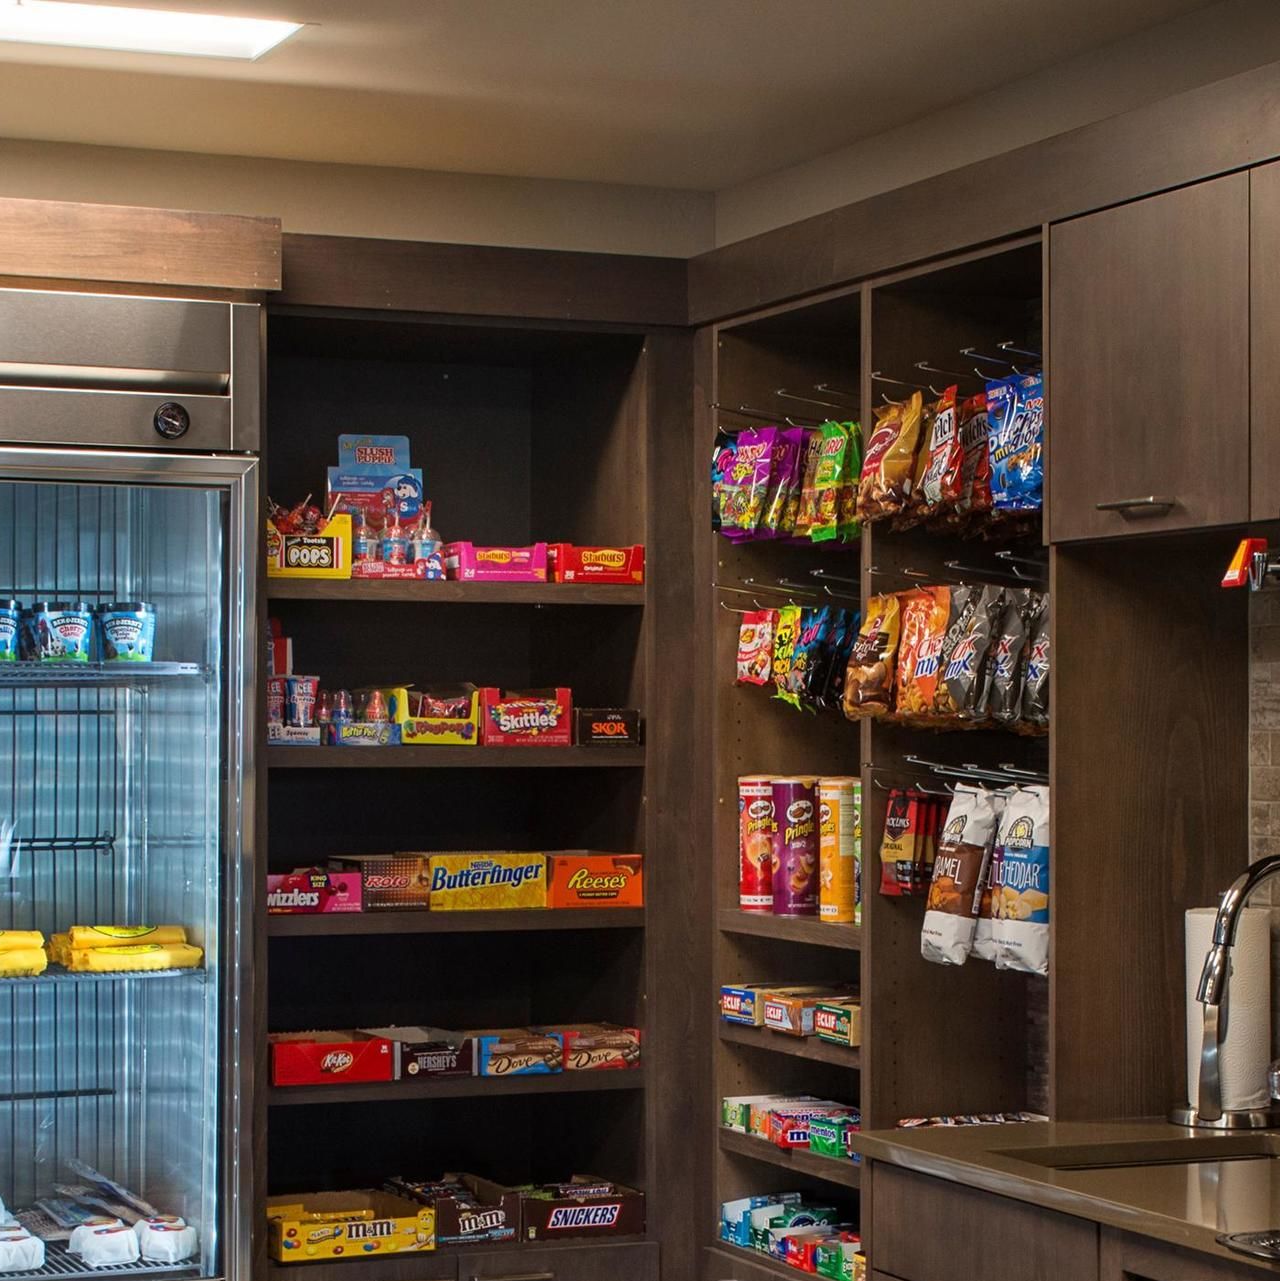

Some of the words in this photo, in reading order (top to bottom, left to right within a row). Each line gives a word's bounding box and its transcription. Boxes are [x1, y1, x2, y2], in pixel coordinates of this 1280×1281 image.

[302, 537, 327, 545] Tootsie
[289, 546, 332, 566] POPS
[476, 550, 512, 563] Starburst
[582, 550, 626, 565] Starburst
[499, 712, 558, 732] Skittles
[591, 721, 628, 735] SKOR
[431, 863, 544, 892] Butterfinger
[568, 869, 627, 889] Reese's
[933, 855, 962, 885] RAMEL
[267, 888, 320, 907] wizzlers
[769, 1008, 783, 1021] CLIF
[820, 1013, 837, 1030] CLIF
[810, 1125, 837, 1140] mentos
[551, 1205, 619, 1227] SNICKERS
